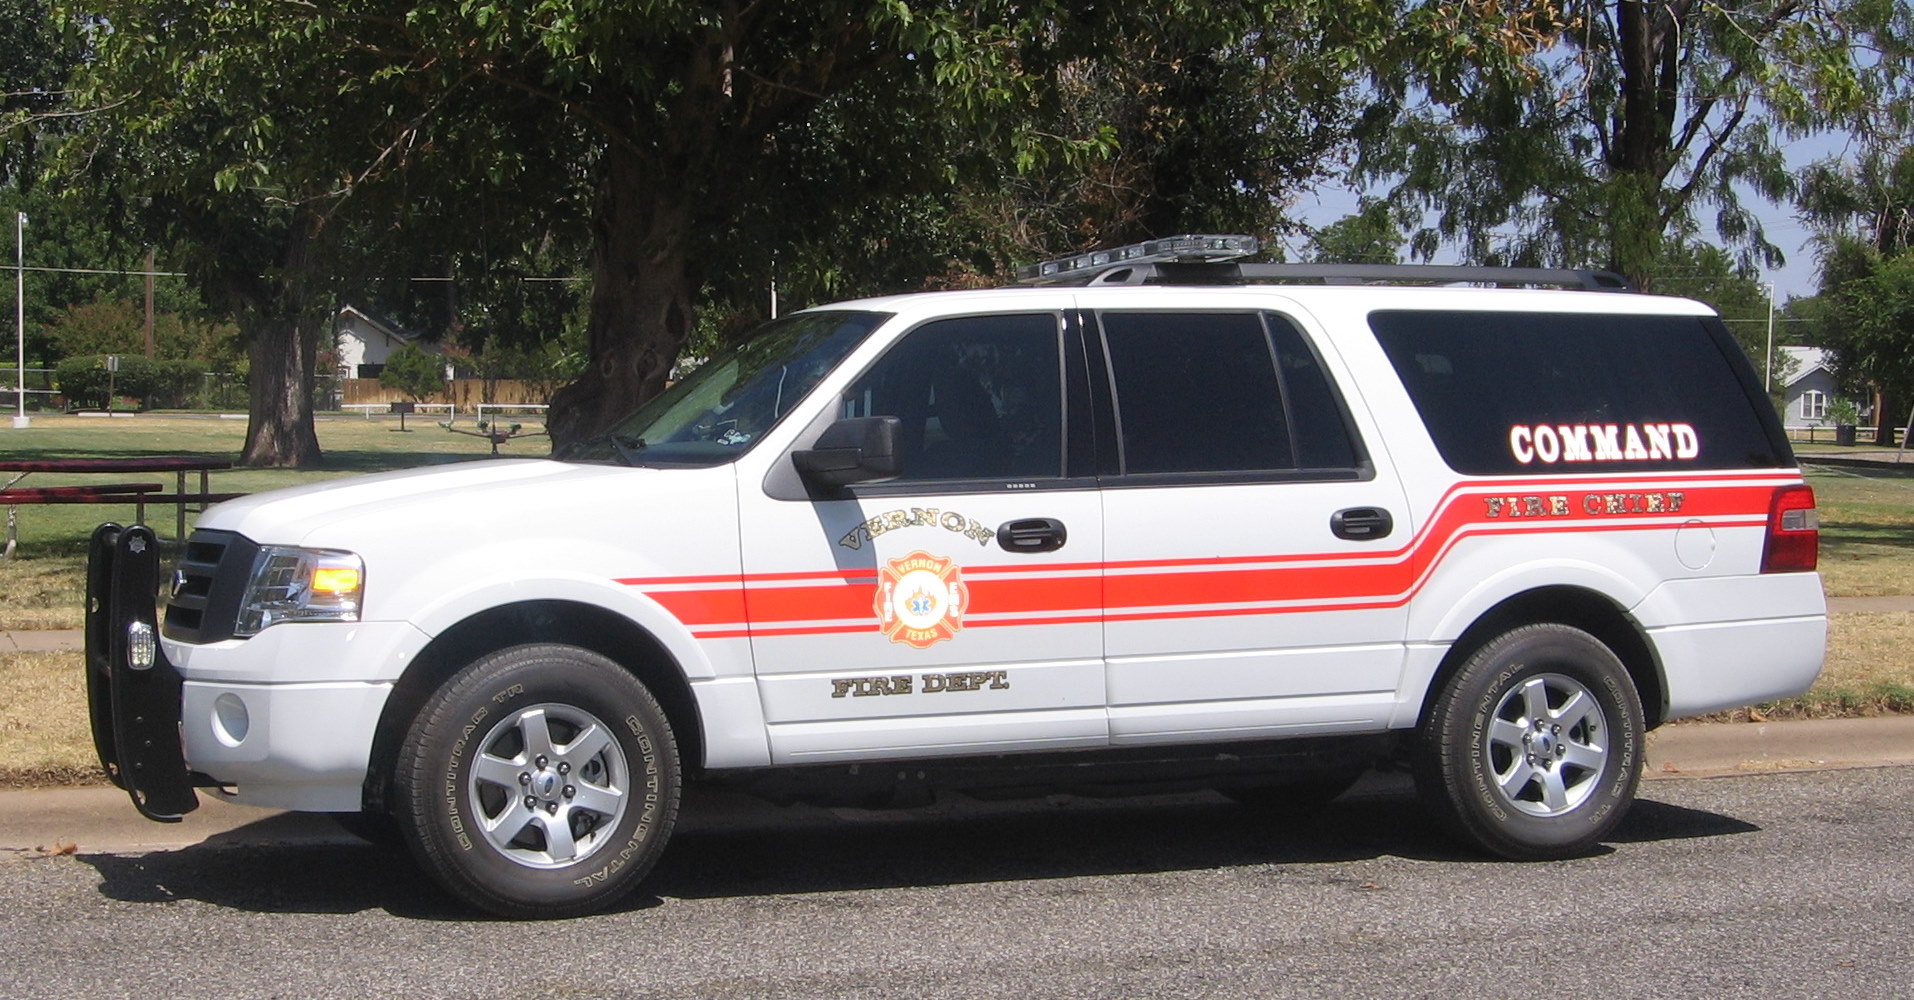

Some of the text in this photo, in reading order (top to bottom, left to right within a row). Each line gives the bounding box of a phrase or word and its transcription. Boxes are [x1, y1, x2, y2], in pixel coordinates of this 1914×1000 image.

[1509, 423, 1699, 464] COMMAND
[1484, 491, 1685, 518] FIRE CHIEF
[838, 507, 996, 551] VERNON
[896, 558, 943, 574] VERNON
[905, 628, 938, 641] TEXAS
[831, 670, 1011, 699] FIRE DEPT.
[1469, 662, 1525, 822] CONTINENTAL
[573, 715, 660, 888] CONTINENTAL
